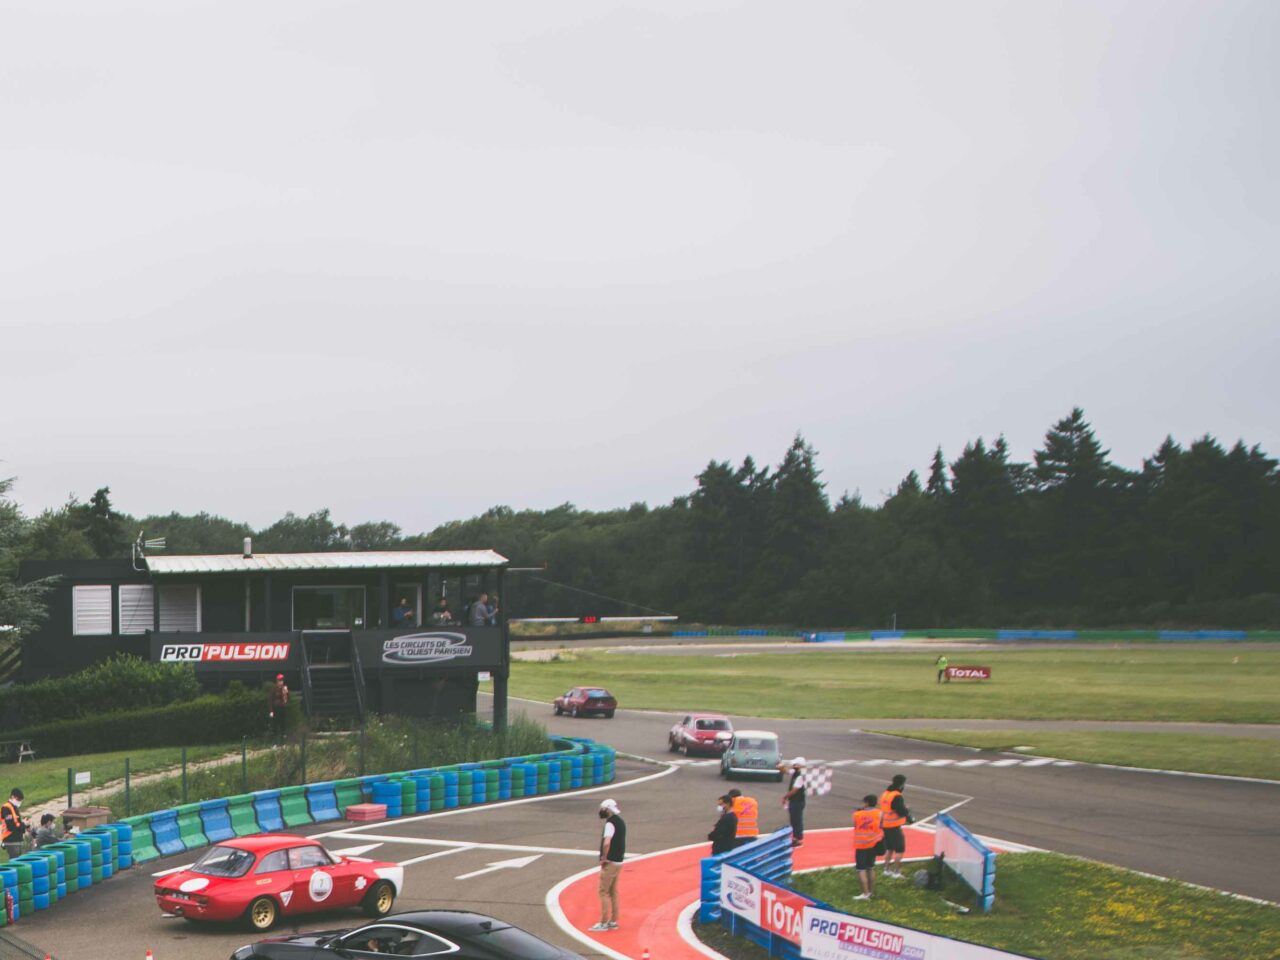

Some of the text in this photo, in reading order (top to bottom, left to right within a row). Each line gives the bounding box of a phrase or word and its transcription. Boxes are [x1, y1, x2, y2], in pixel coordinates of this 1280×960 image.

[385, 640, 447, 649] LES CIRCUITS DE
[162, 644, 288, 660] PRO'PULSION
[401, 646, 471, 656] L'OUEST PARISIEN
[949, 667, 988, 677] TOTAL
[763, 889, 804, 937] TOTA
